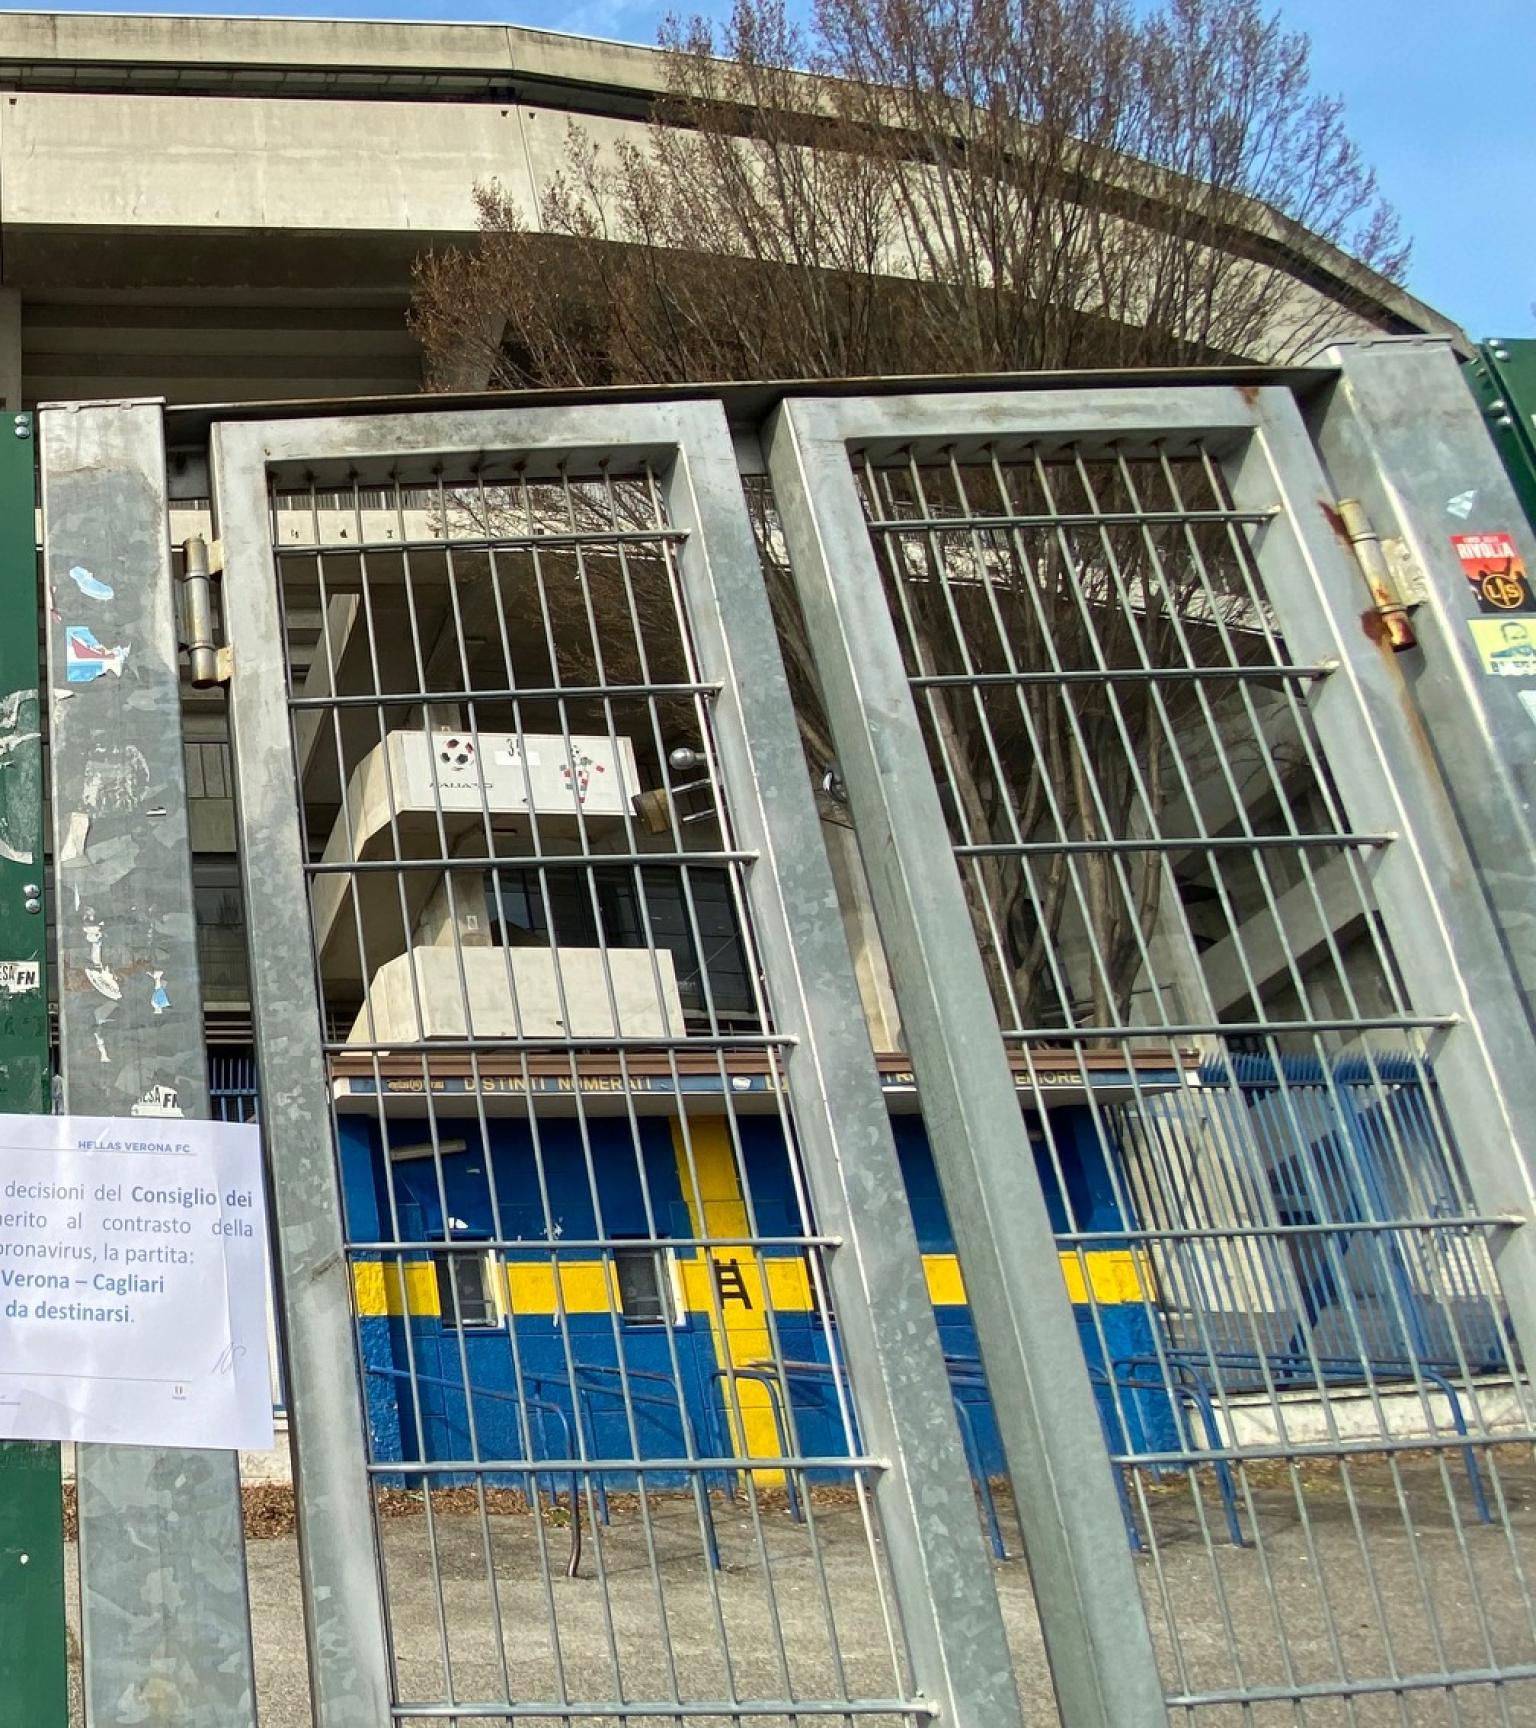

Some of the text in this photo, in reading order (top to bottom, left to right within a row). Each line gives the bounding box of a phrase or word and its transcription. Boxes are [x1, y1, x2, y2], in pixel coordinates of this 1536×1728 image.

[16, 971, 36, 985] FN
[464, 1077, 545, 1091] DSTINTI
[78, 1140, 191, 1153] HELLAS VERONA FC
[4, 1180, 85, 1201] decisioni
[94, 1184, 122, 1202] del
[131, 1186, 217, 1208] Consiglio
[226, 1189, 253, 1208] dei
[66, 1212, 82, 1229] al
[102, 1215, 192, 1234] contrasto
[211, 1219, 254, 1237] della
[103, 1242, 120, 1261] la
[125, 1246, 195, 1266] partita:
[1, 1269, 70, 1289] Verona
[92, 1273, 164, 1295] Cagliari
[5, 1299, 29, 1318] da
[34, 1300, 136, 1324] destinarsi.
